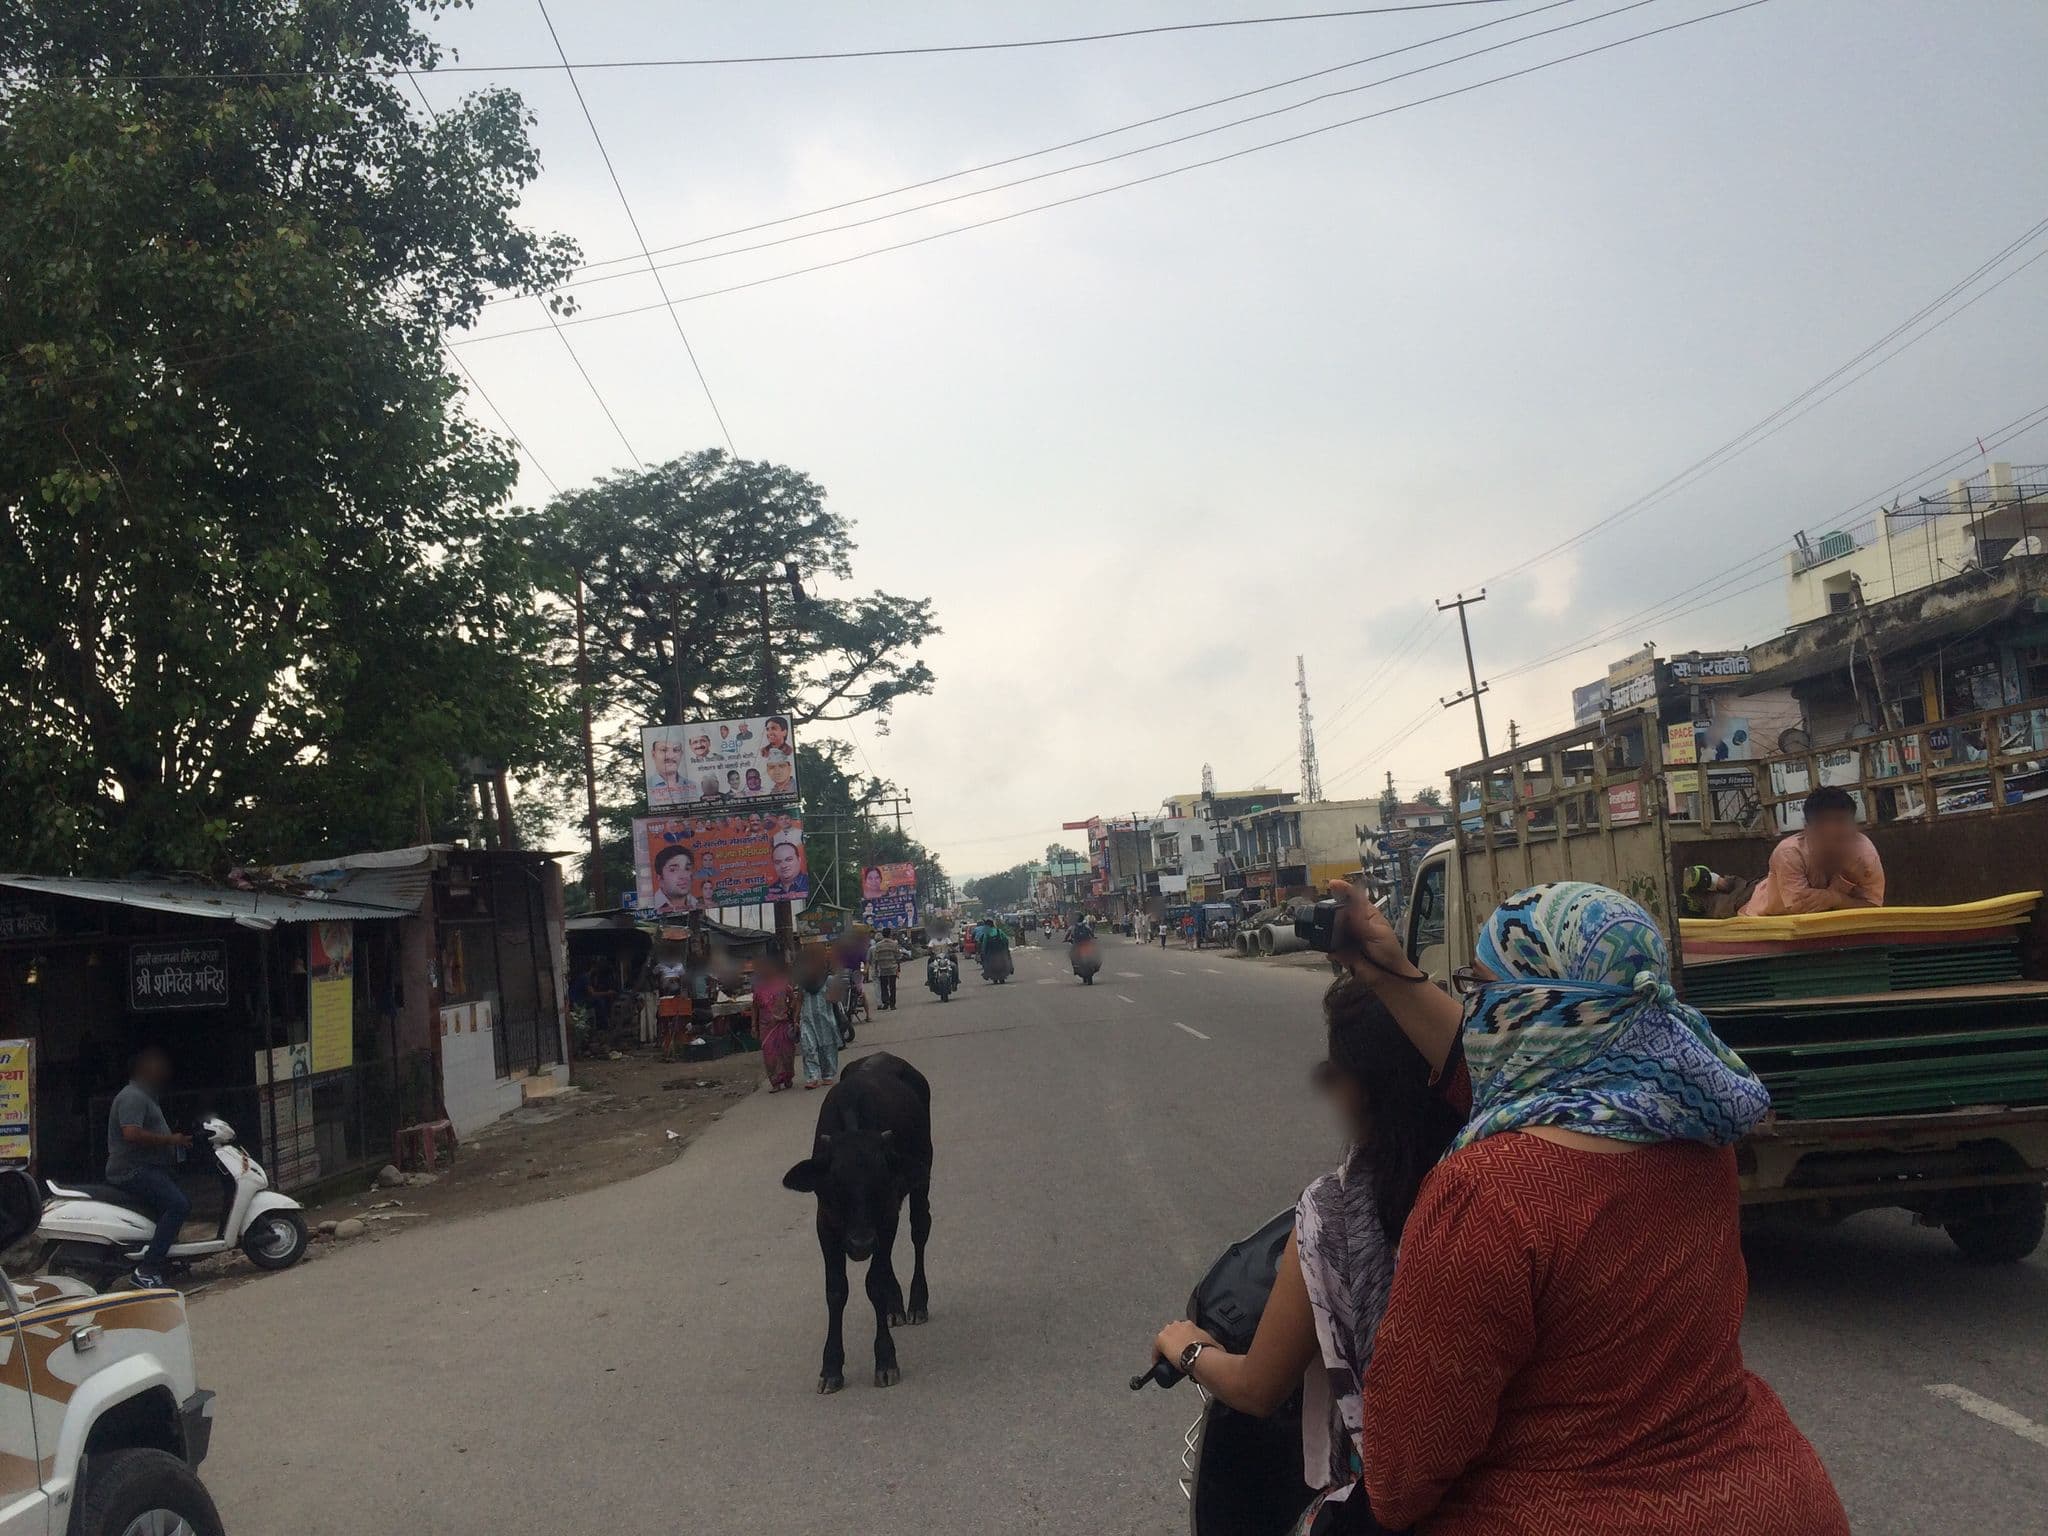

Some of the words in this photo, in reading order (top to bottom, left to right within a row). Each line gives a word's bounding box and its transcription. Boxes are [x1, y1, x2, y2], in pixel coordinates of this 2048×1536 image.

[1714, 657, 1750, 675] क्लीनि
[1670, 727, 1693, 739] SPACE
[720, 739, 743, 753] aap
[1728, 775, 1753, 785] fitness
[136, 967, 151, 995] श्री
[154, 967, 192, 997] शनिदेव
[195, 965, 226, 995] मन्दिर
